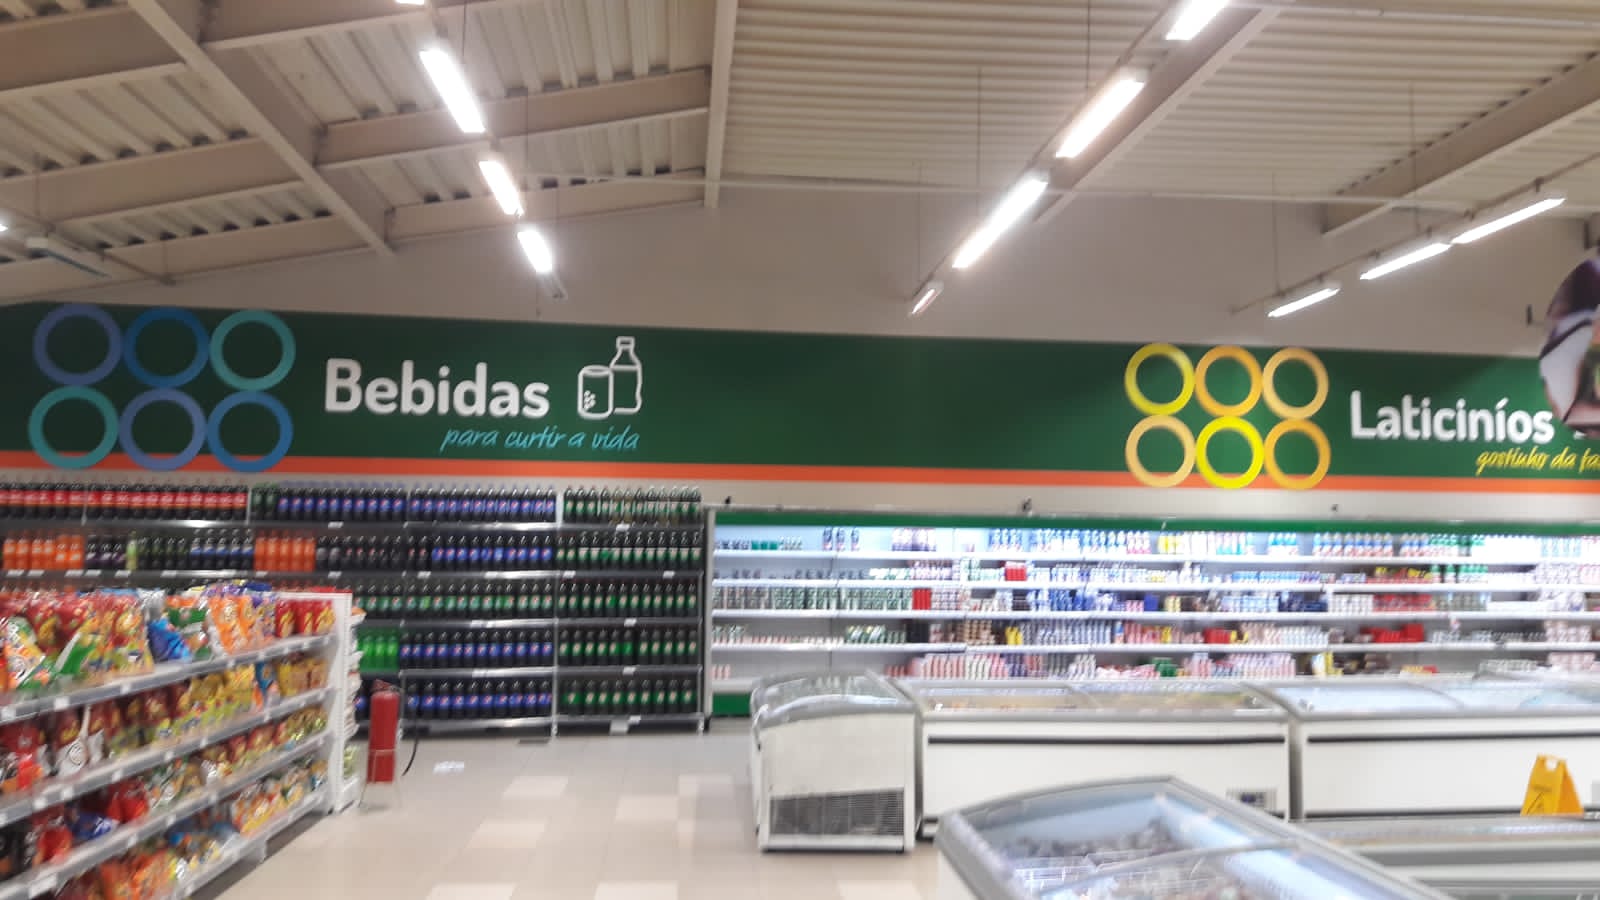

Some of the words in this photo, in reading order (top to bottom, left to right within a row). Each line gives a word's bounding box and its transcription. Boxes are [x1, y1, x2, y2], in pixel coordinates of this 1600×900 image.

[324, 357, 550, 418] Bebidas
[1350, 390, 1555, 444] Laticiníos
[439, 426, 498, 452] para
[504, 425, 566, 449] curtir
[568, 432, 586, 448] a
[591, 425, 640, 450] vida
[1550, 446, 1577, 469] da
